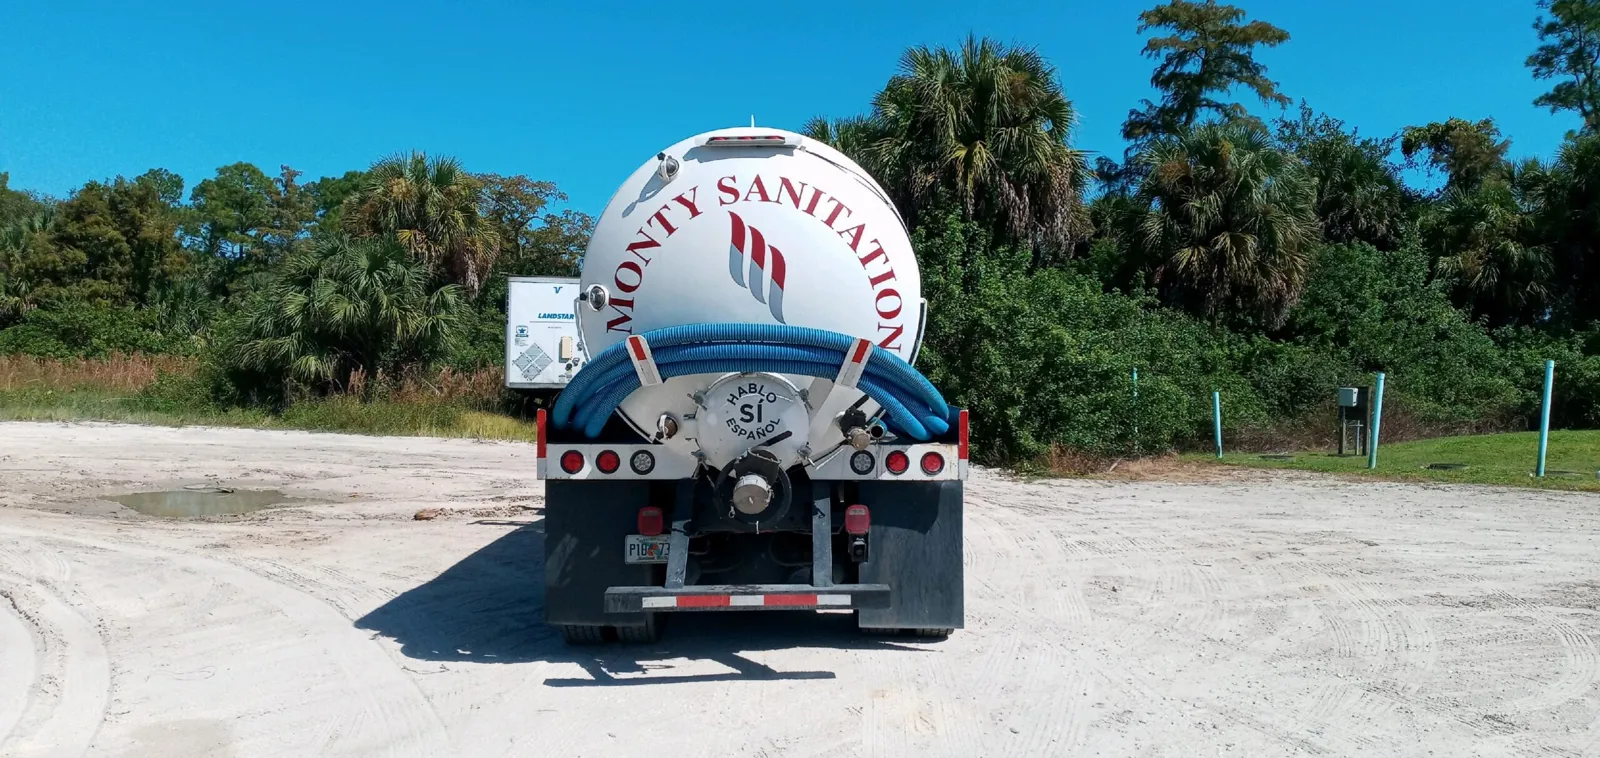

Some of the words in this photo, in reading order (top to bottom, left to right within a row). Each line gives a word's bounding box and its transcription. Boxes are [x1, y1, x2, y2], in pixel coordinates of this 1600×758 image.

[606, 186, 703, 335] MONTY
[716, 174, 904, 352] SANITATION
[726, 383, 777, 406] HABLO
[740, 399, 764, 423] SÍ
[726, 417, 781, 440] ESPAÑOL
